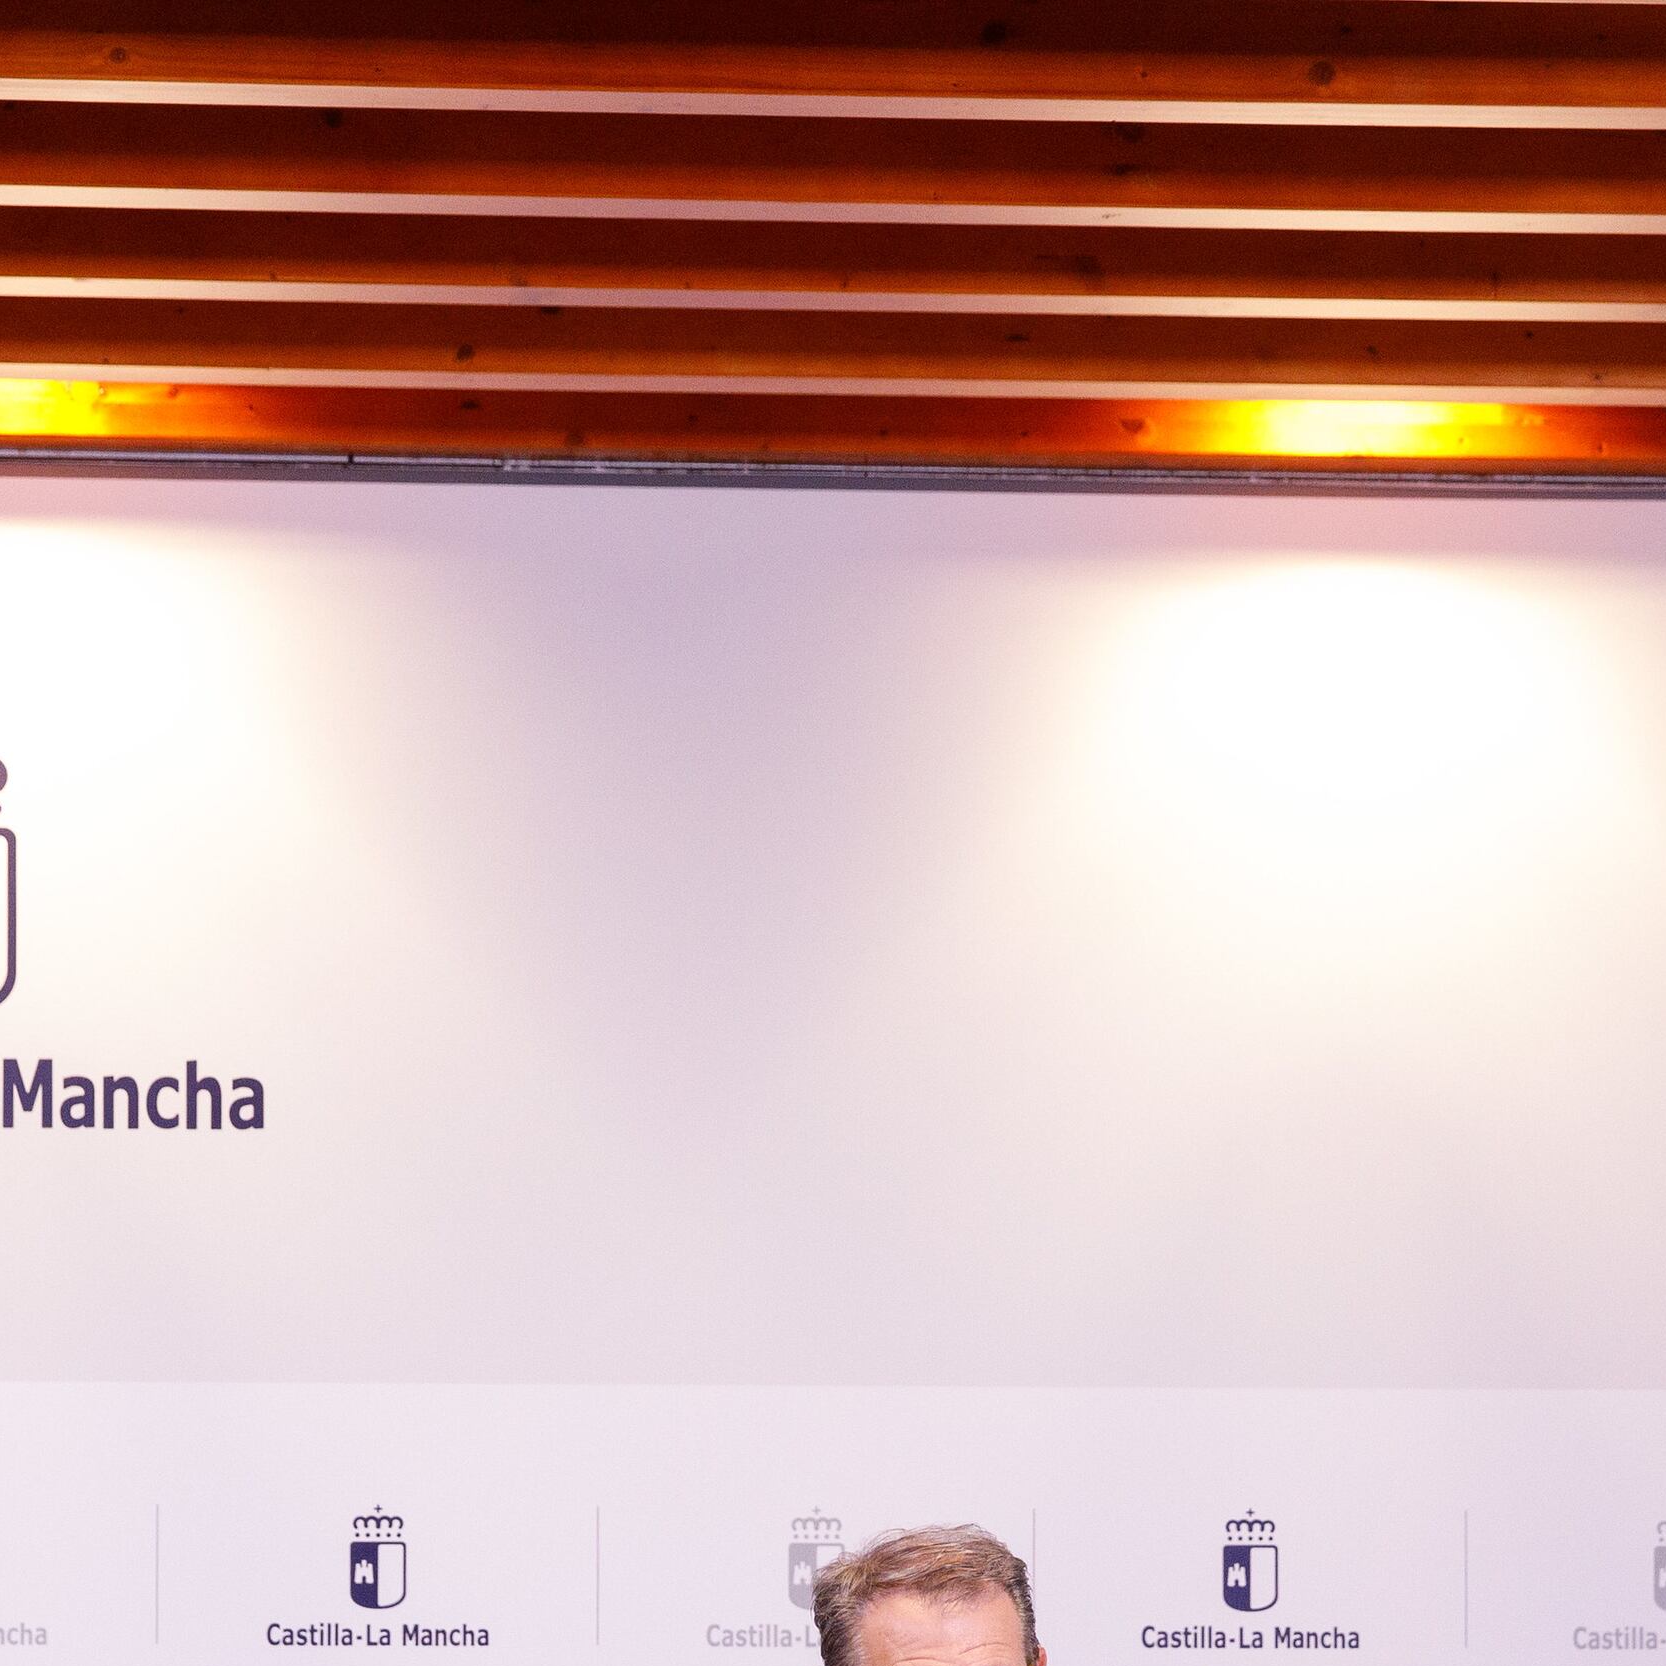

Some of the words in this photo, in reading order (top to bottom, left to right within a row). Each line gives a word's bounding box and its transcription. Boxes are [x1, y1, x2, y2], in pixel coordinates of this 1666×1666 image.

[3, 1059, 264, 1130] Mancha
[267, 1623, 391, 1646] Castilla-La
[403, 1624, 489, 1646] Mancha
[706, 1623, 823, 1648] Castilla-L
[1142, 1626, 1263, 1649] Castilla-La
[1275, 1627, 1359, 1649] Mancha
